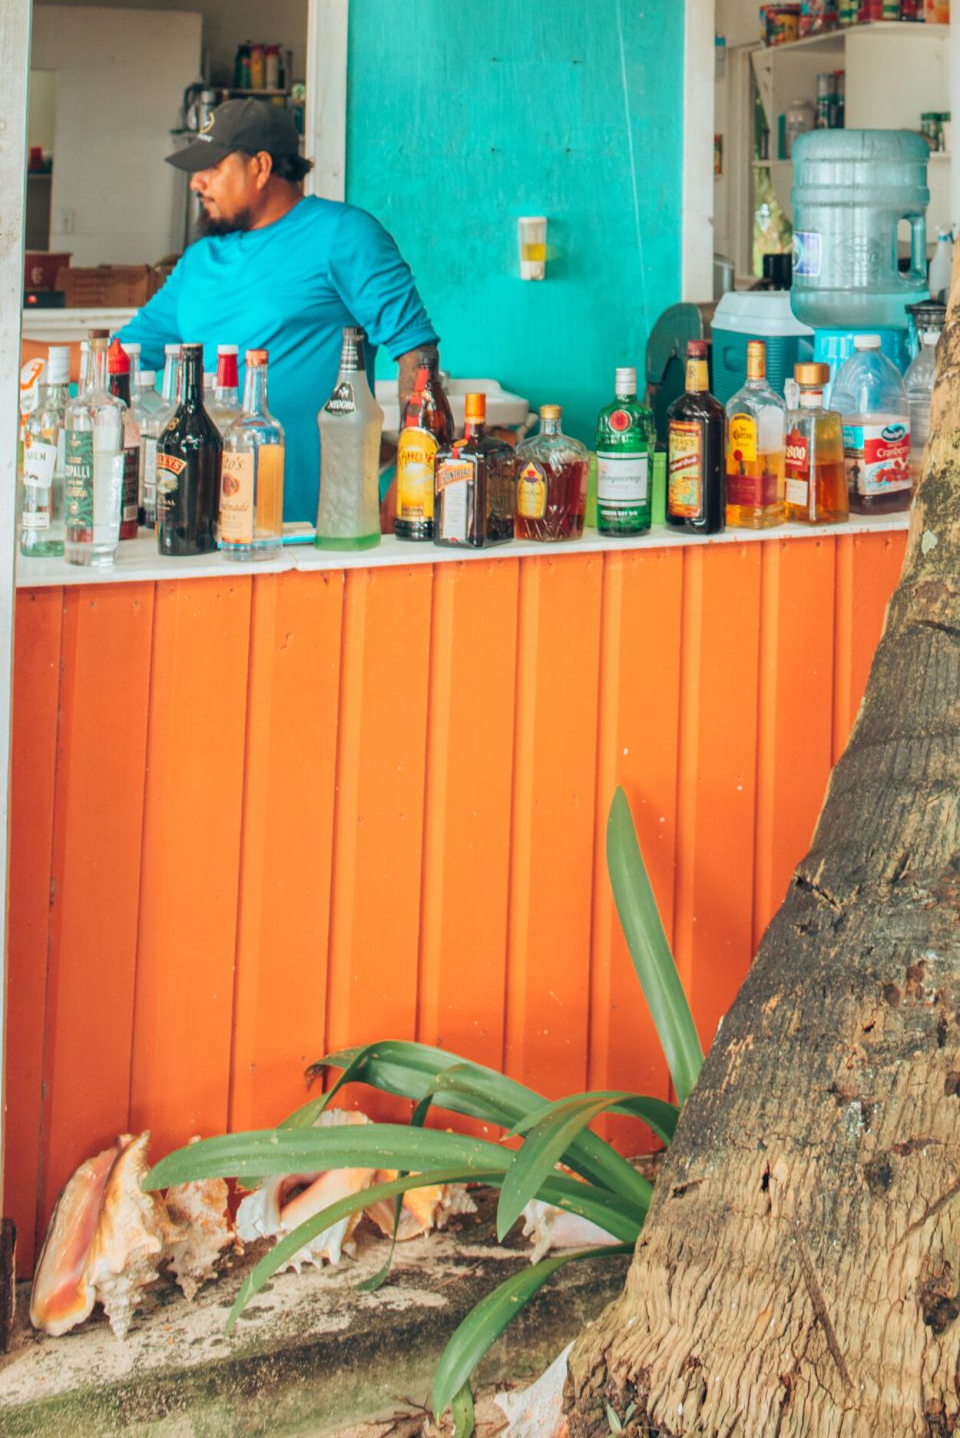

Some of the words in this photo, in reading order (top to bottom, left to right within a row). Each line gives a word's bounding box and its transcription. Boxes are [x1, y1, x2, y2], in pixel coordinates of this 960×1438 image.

[785, 445, 806, 460] 800
[159, 454, 180, 470] LEYS
[64, 464, 90, 478] OPALLI
